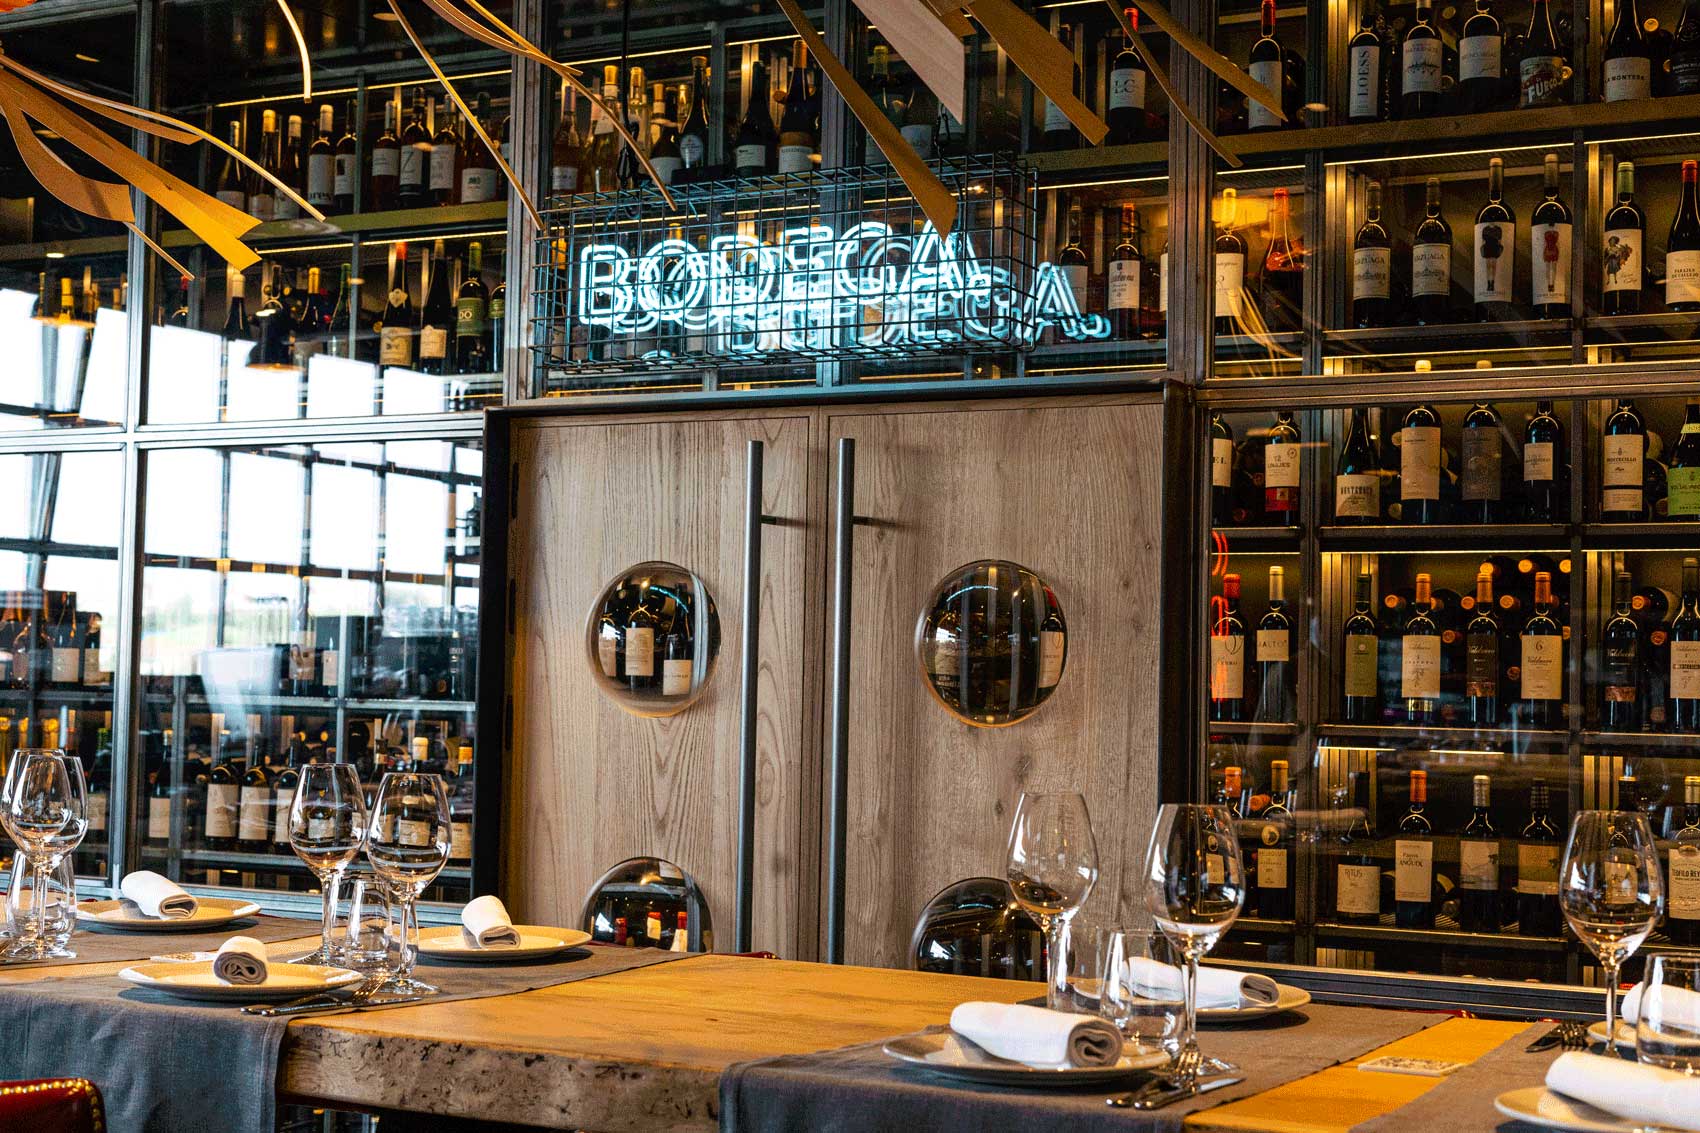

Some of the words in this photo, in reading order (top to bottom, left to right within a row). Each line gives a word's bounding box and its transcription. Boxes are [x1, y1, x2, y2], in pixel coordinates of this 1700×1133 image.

[1357, 50, 1370, 97] LOESS
[579, 219, 992, 326] BODEGA
[1535, 640, 1543, 651] 6
